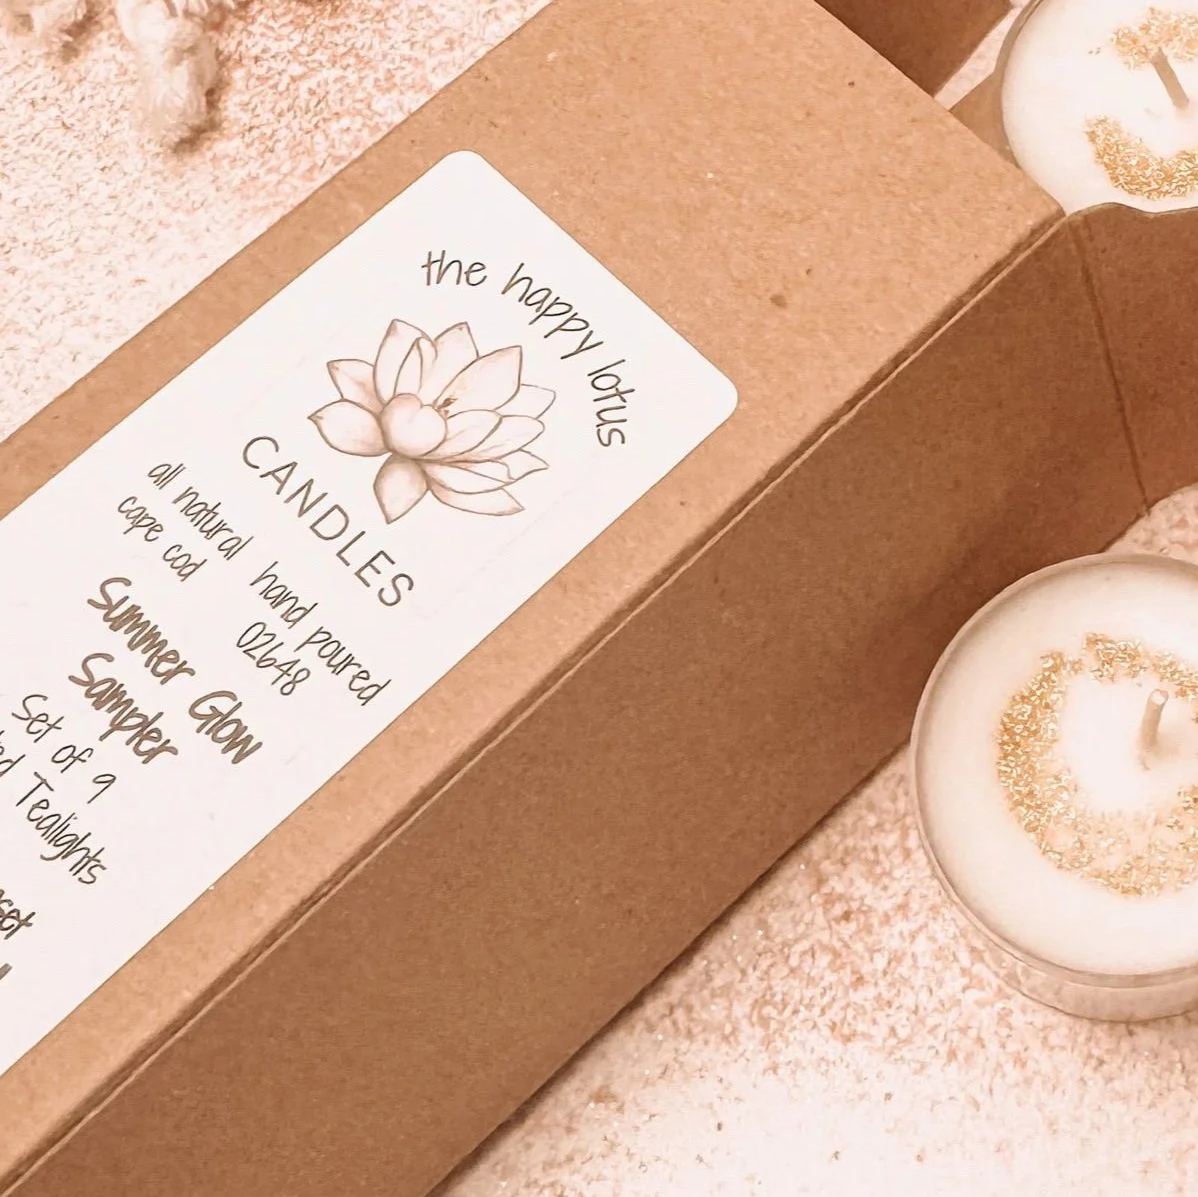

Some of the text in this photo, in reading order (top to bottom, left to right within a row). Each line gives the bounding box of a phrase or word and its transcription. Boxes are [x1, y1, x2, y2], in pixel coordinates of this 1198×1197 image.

[420, 249, 635, 447] the happy lotus
[117, 496, 310, 696] cape cod 02648
[147, 463, 391, 706] all natural hand poured
[242, 435, 414, 606] CANDLES
[11, 693, 64, 742] Set
[50, 744, 93, 773] of
[87, 773, 116, 803] 9
[68, 653, 178, 764] Sampler
[86, 576, 262, 764] Summer Glow
[15, 771, 106, 884] Tealights
